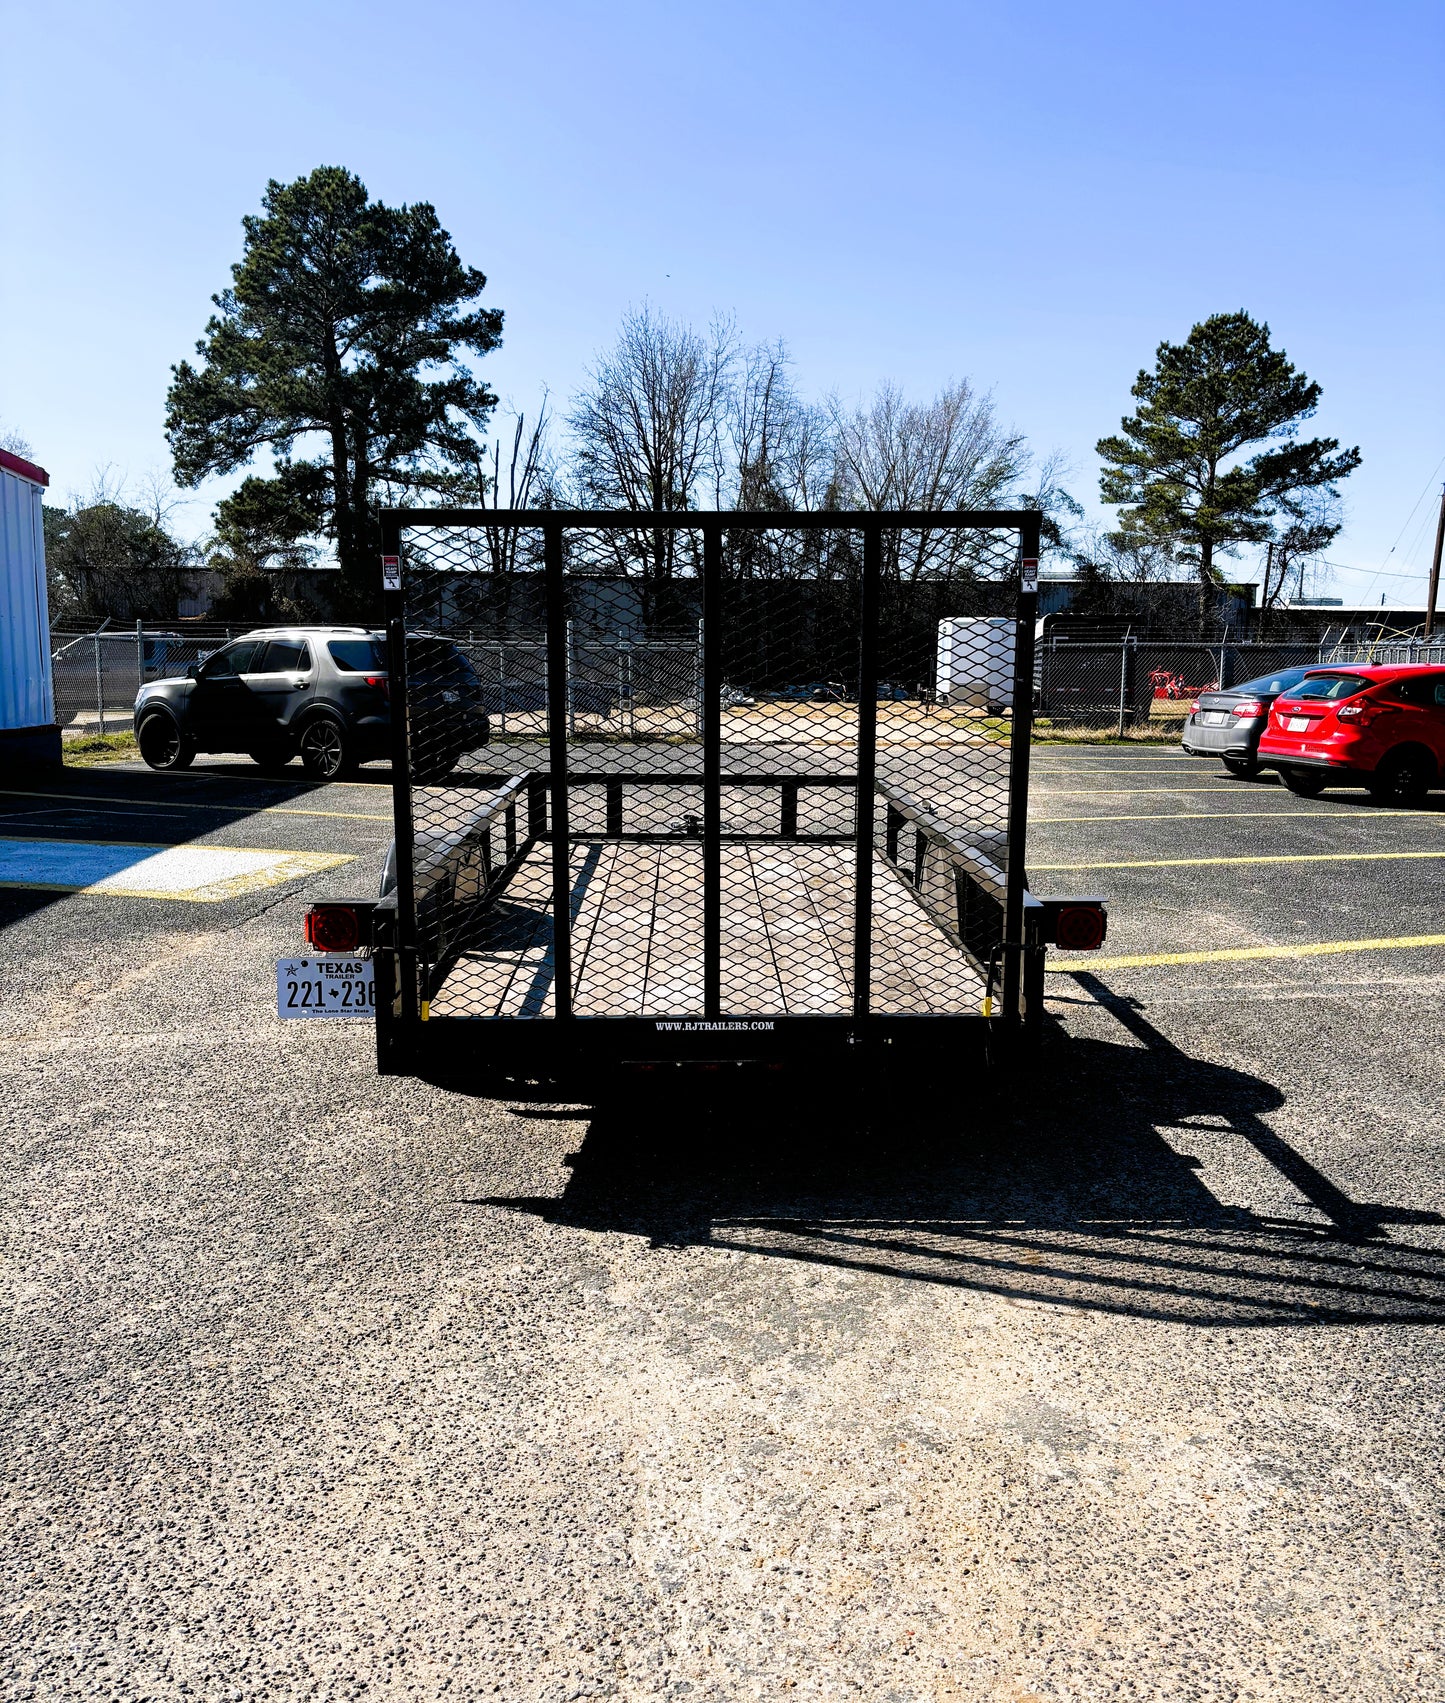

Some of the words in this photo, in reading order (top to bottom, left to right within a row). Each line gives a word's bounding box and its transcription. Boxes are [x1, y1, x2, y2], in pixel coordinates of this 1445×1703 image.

[316, 963, 363, 974] TEXAS
[287, 981, 326, 1008] 221
[655, 1022, 774, 1031] WWW.RJTRAILERS.COM
